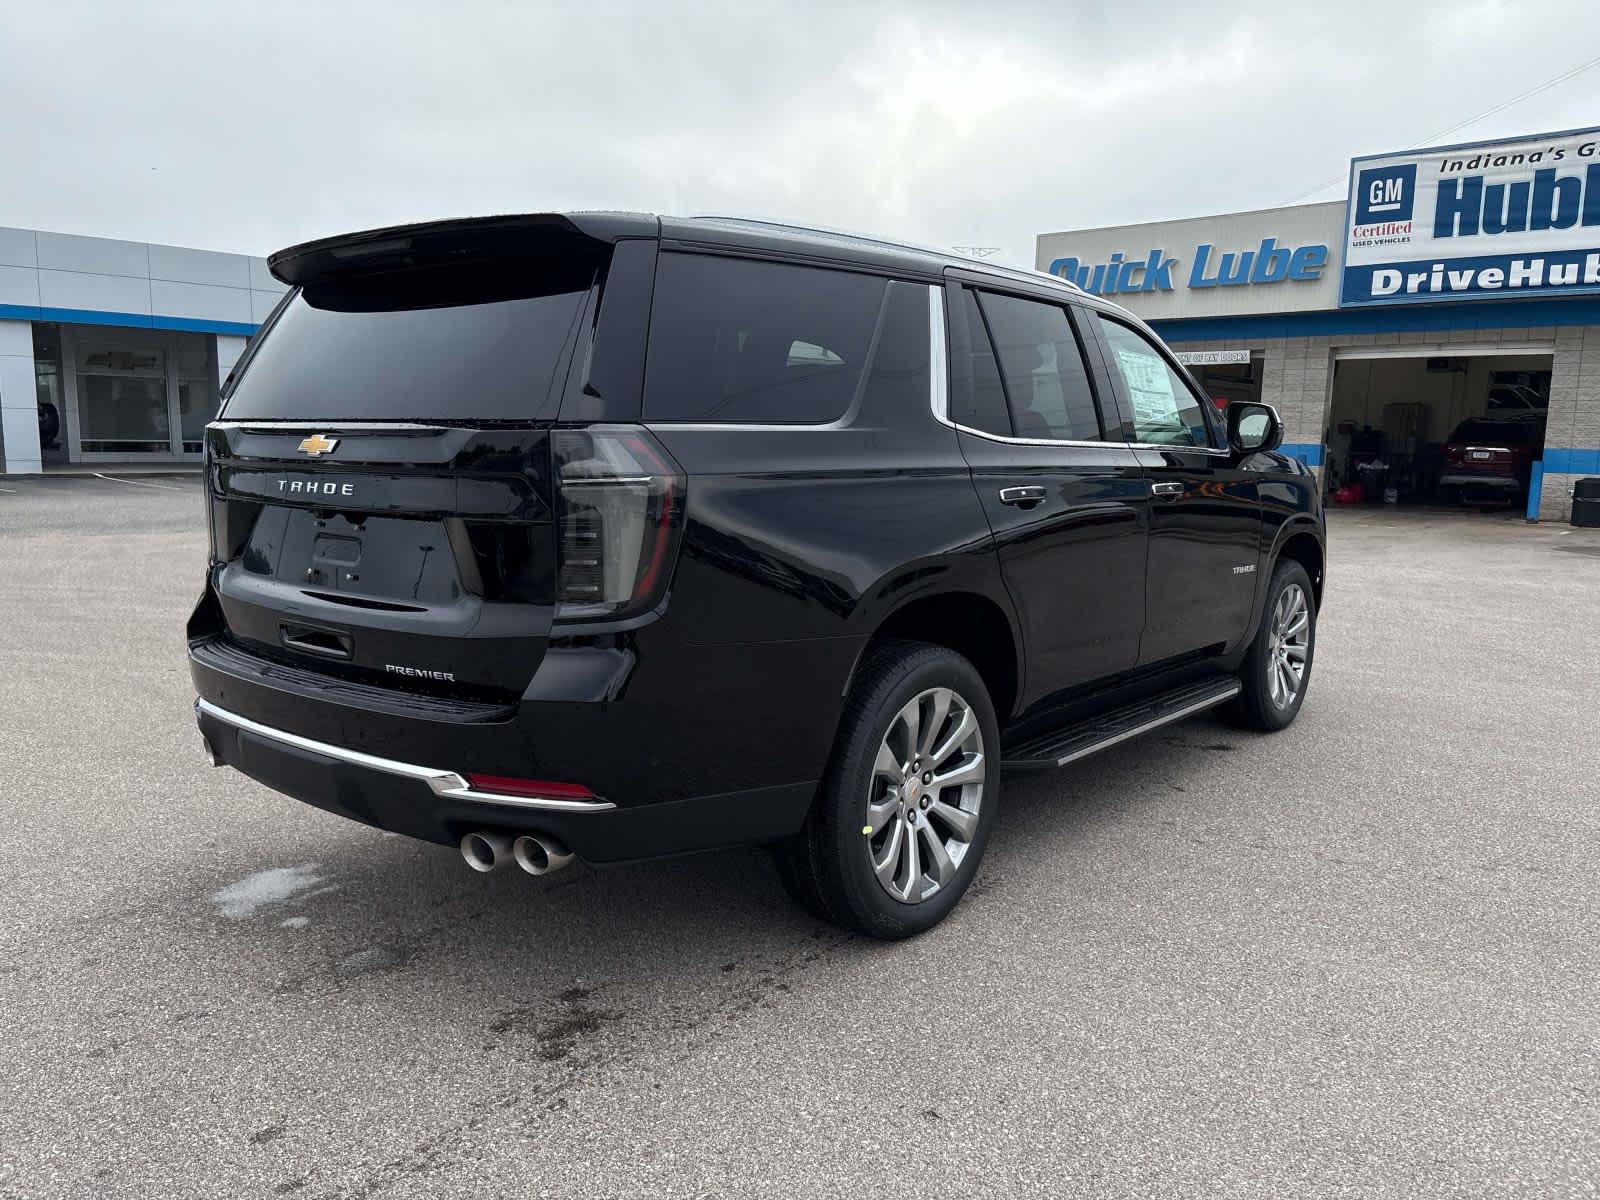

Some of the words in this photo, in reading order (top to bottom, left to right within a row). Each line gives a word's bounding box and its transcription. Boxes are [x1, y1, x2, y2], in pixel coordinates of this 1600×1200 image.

[1439, 146, 1566, 173] Indiana's
[1577, 142, 1600, 158] G
[1368, 177, 1404, 205] GM
[1353, 221, 1412, 238] Certified
[1352, 239, 1373, 248] USED
[1374, 236, 1411, 246] VEHICLES
[1186, 236, 1330, 290] Lube
[1220, 350, 1248, 361] DOORS
[278, 480, 355, 496] TAHOE
[1232, 564, 1256, 575] TAHOE
[385, 663, 456, 682] PREMIER
